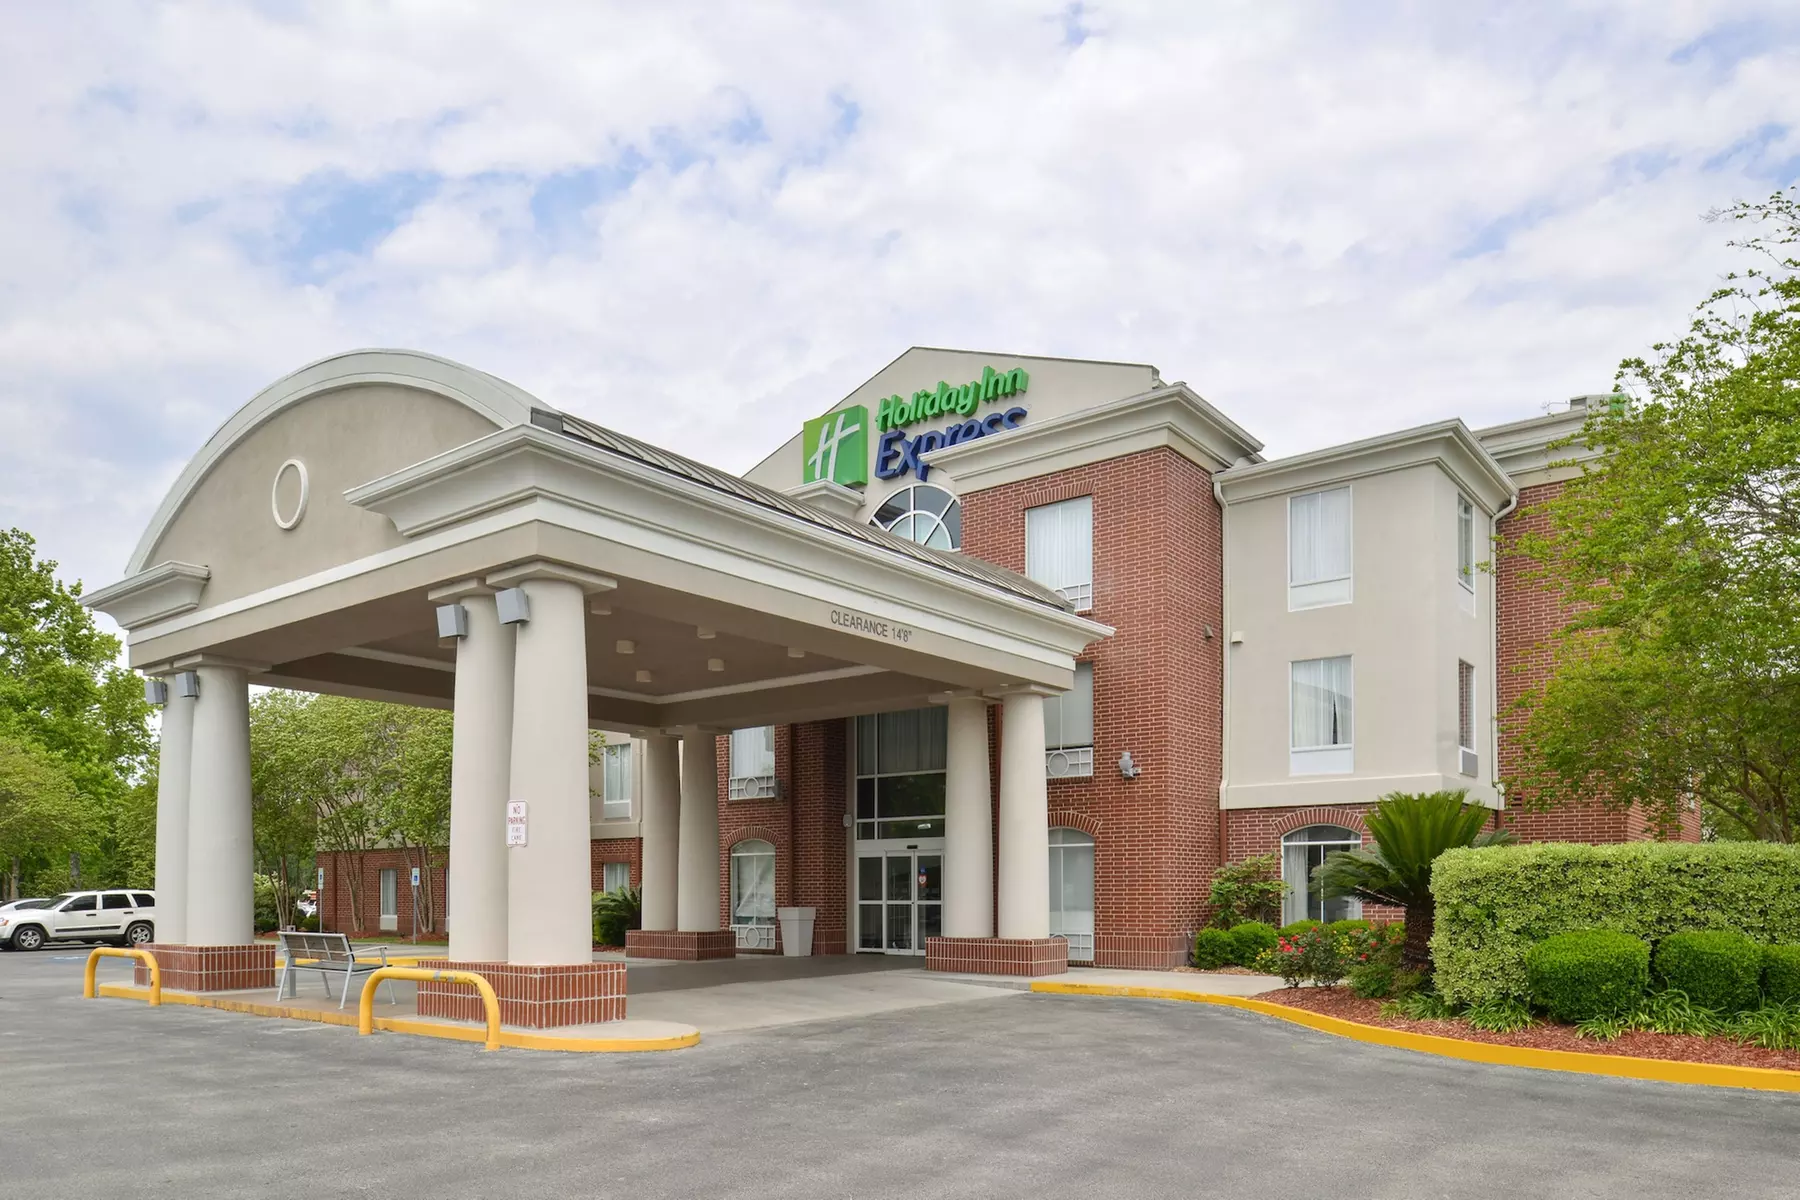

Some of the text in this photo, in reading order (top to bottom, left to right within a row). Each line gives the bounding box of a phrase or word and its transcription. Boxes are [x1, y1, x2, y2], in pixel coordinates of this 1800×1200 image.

[875, 366, 1029, 433] Holiday Inn
[875, 407, 1028, 482] Express
[830, 609, 912, 643] CLEARANCE 14'8"
[507, 816, 526, 825] PARKING
[512, 805, 521, 815] NO
